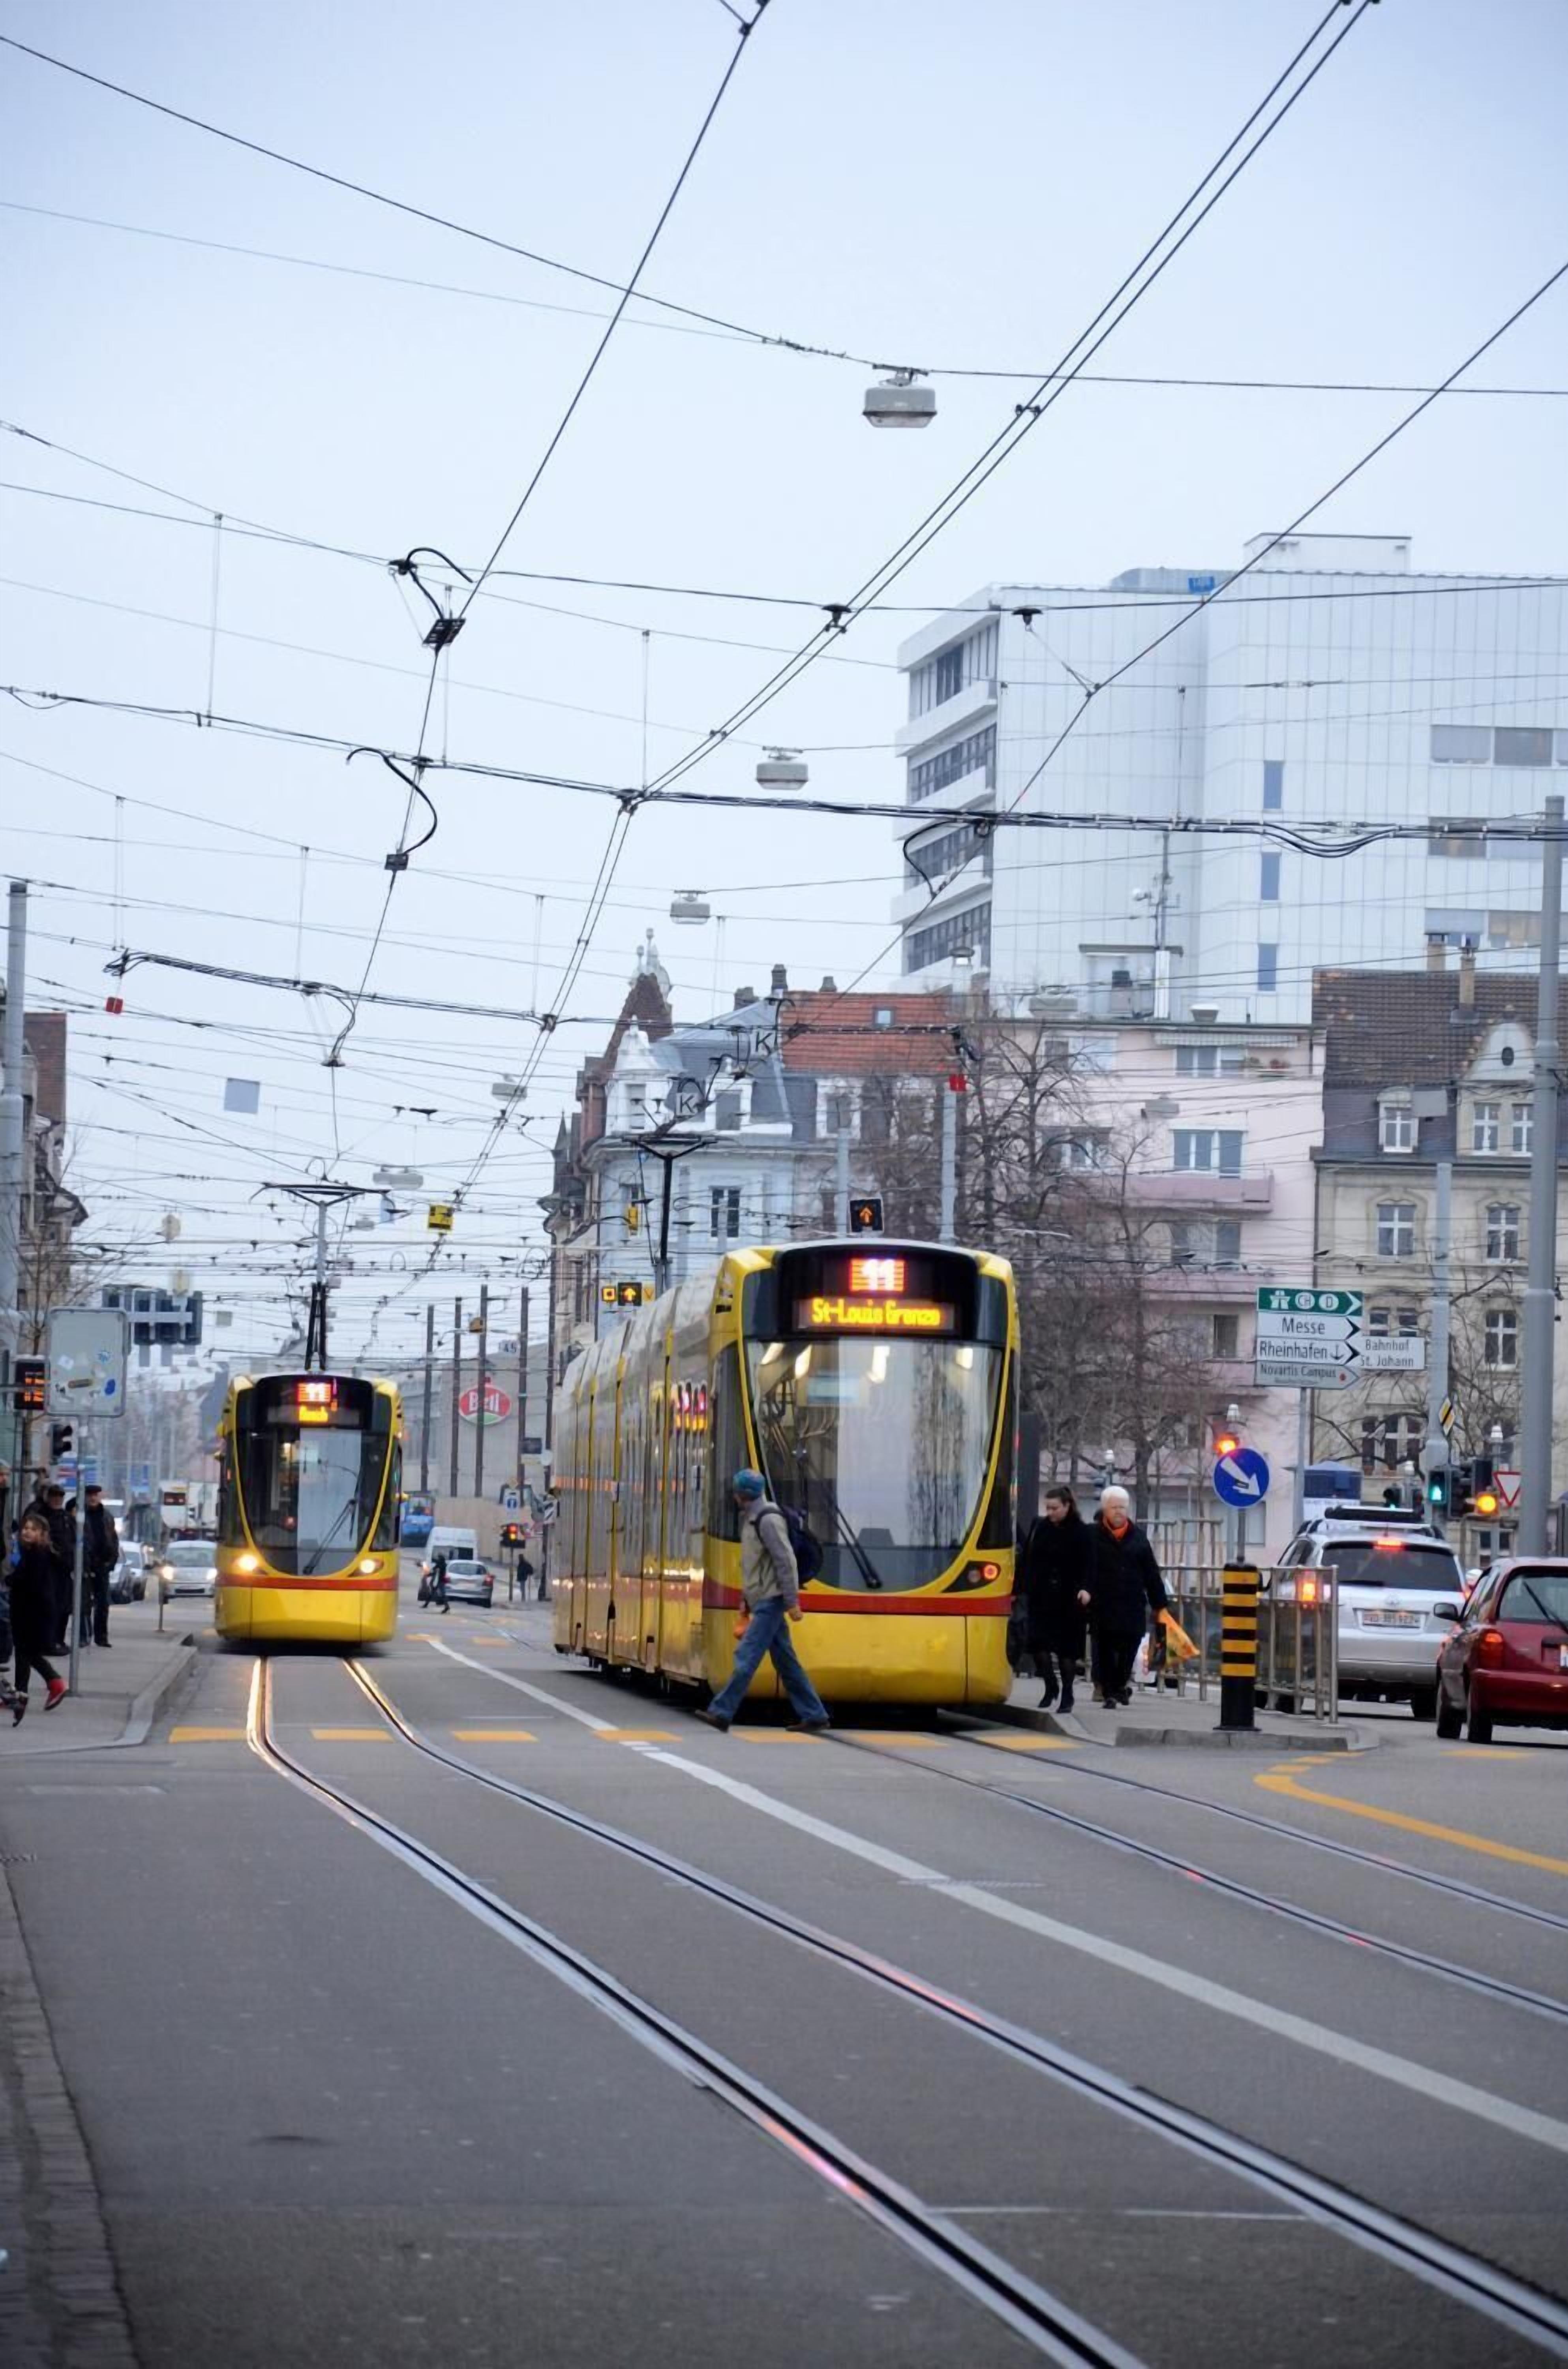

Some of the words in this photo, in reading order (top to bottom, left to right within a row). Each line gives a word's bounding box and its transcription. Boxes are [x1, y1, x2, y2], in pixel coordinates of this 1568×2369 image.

[680, 1094, 695, 1113] K
[861, 1258, 895, 1291] 11
[1298, 1294, 1311, 1307] CH
[1326, 1296, 1334, 1308] D
[1282, 1316, 1325, 1335] Messe
[1260, 1340, 1327, 1359] Rheinhafen
[1365, 1338, 1409, 1351] Bahnhof
[1377, 1355, 1414, 1368] Johann
[1260, 1363, 1298, 1376] Novartis
[1301, 1365, 1337, 1379] Campus
